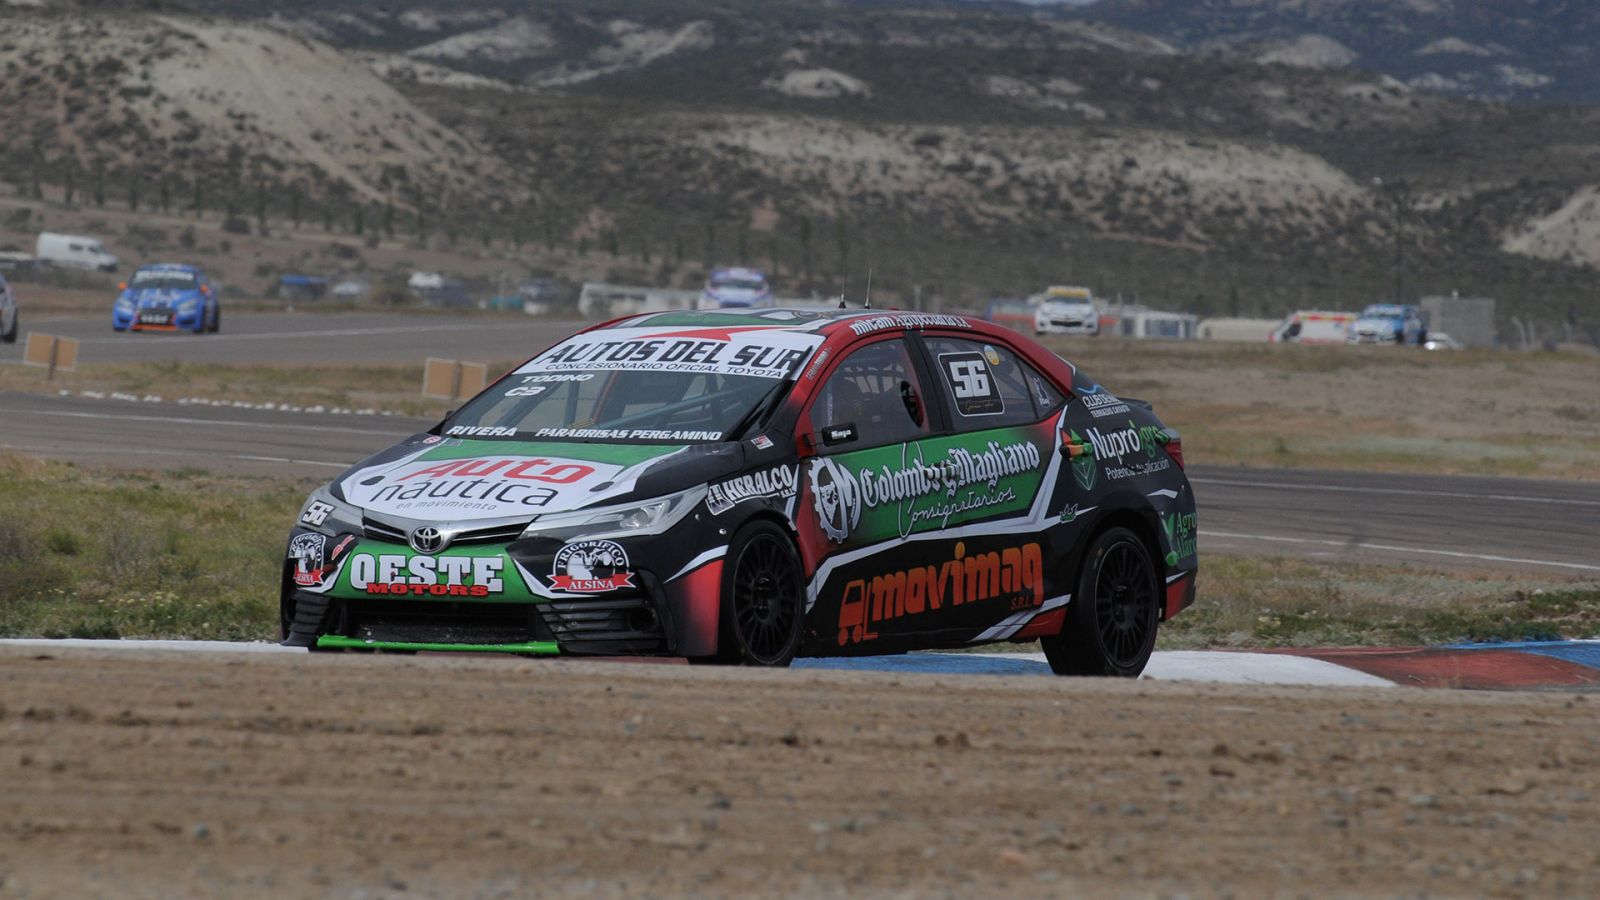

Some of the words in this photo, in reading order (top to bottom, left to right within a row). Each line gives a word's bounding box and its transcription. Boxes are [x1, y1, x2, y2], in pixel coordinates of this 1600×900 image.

[535, 340, 665, 365] AUTOS
[656, 340, 728, 364] DEL
[728, 344, 805, 370] SUR
[521, 374, 595, 384] TODINO
[545, 361, 662, 371] CONCESIONARIO
[665, 362, 720, 373] OFICIAL
[726, 366, 782, 378] TOYOTA
[948, 360, 991, 398] 56
[505, 386, 546, 397] C3
[446, 425, 518, 437] RIVERA
[535, 427, 628, 439] PARABRISAS
[629, 429, 723, 442] PERGAMINO
[948, 441, 1041, 491] Magliano
[369, 478, 559, 507] náutica
[722, 464, 793, 502] HERALCO
[301, 500, 335, 526] 56
[395, 501, 412, 510] en
[416, 500, 497, 511] movimiento
[557, 541, 625, 569] FRIGORIFICO
[350, 554, 503, 592] OESTE
[569, 580, 615, 590] ALSINA
[367, 582, 489, 597] MOTORS
